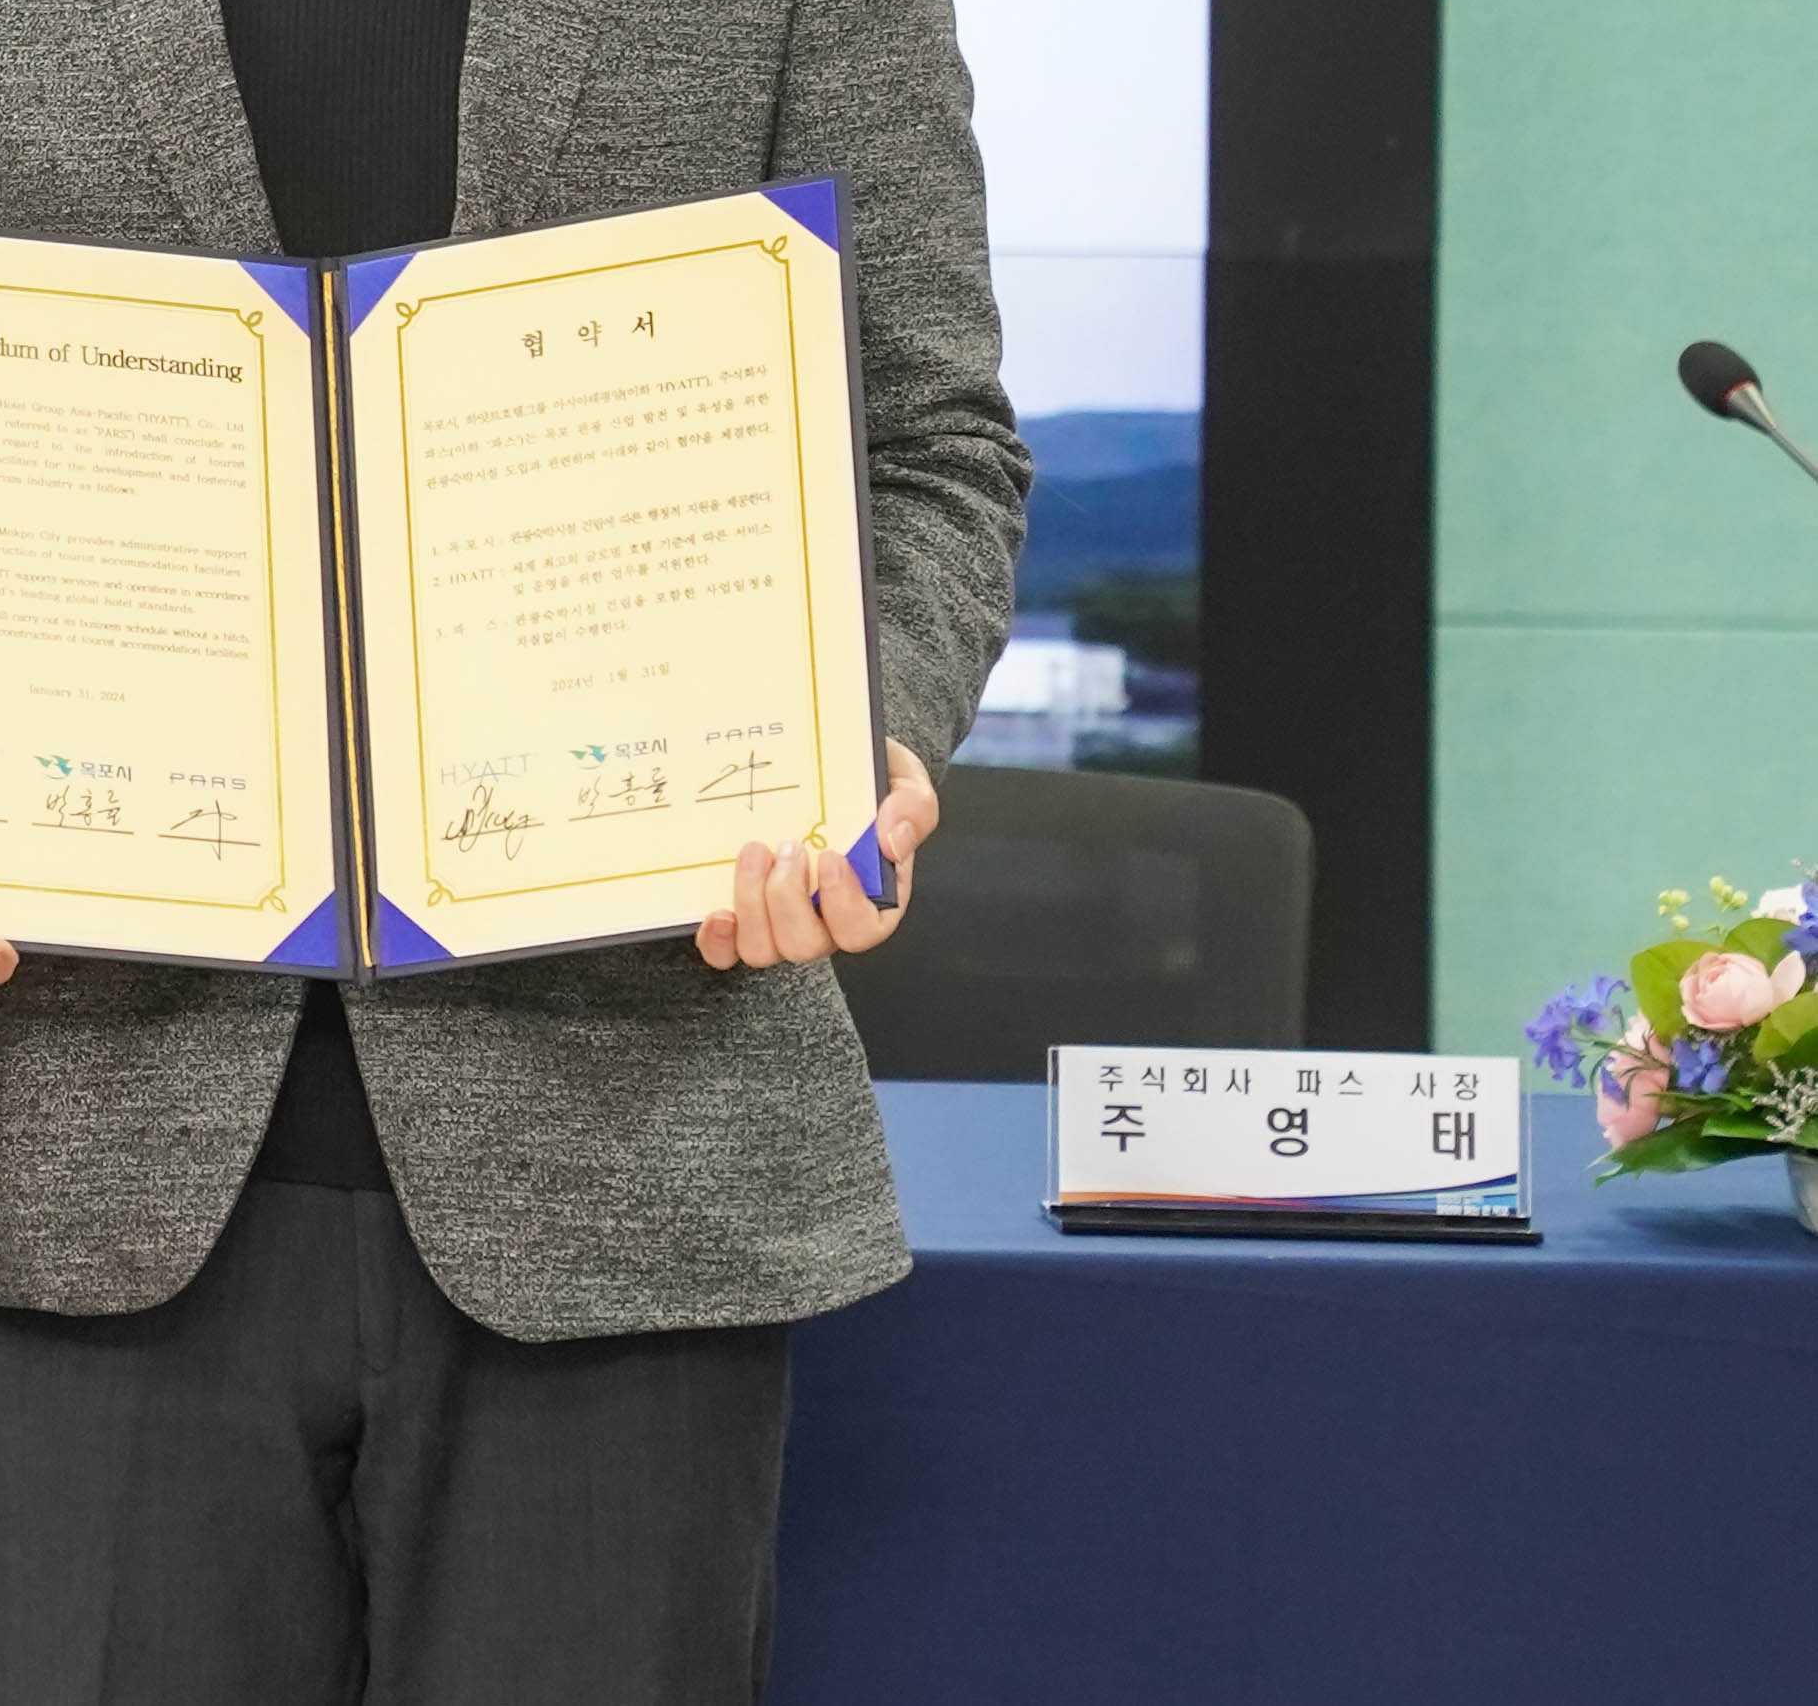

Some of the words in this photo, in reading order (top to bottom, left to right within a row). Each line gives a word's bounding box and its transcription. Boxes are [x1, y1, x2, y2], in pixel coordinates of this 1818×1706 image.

[48, 343, 72, 363] of
[81, 345, 244, 384] Understanding
[704, 721, 784, 745] PARS
[615, 737, 668, 760] 목포시
[80, 761, 132, 783] 목포시
[168, 772, 247, 791] PARS
[440, 752, 531, 786] HYATT
[1100, 1066, 1251, 1094] 주식회사
[1297, 1070, 1362, 1096] 파스
[1411, 1073, 1478, 1100] 사장
[1101, 1105, 1146, 1152] 주
[1267, 1108, 1308, 1157] 영
[1433, 1112, 1475, 1160] 태
